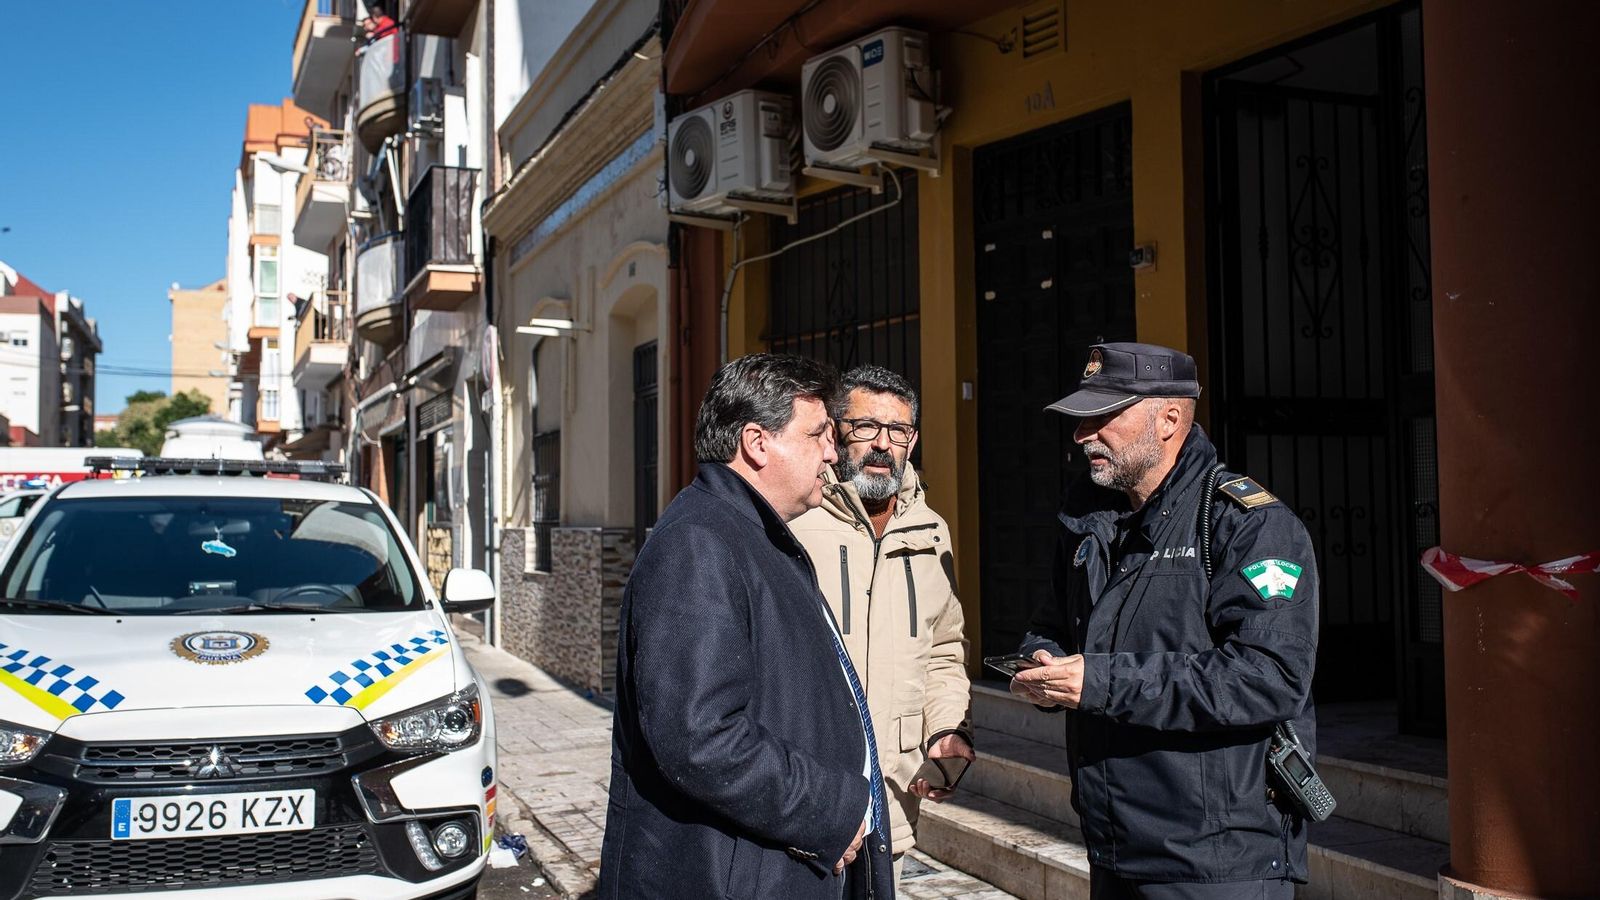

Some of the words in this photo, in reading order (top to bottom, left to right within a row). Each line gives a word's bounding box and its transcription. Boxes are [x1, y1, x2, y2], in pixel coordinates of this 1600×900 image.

[1150, 546, 1196, 560] PLICIA
[138, 800, 227, 833] 9926
[242, 795, 305, 828] KZX
[118, 823, 126, 832] E
